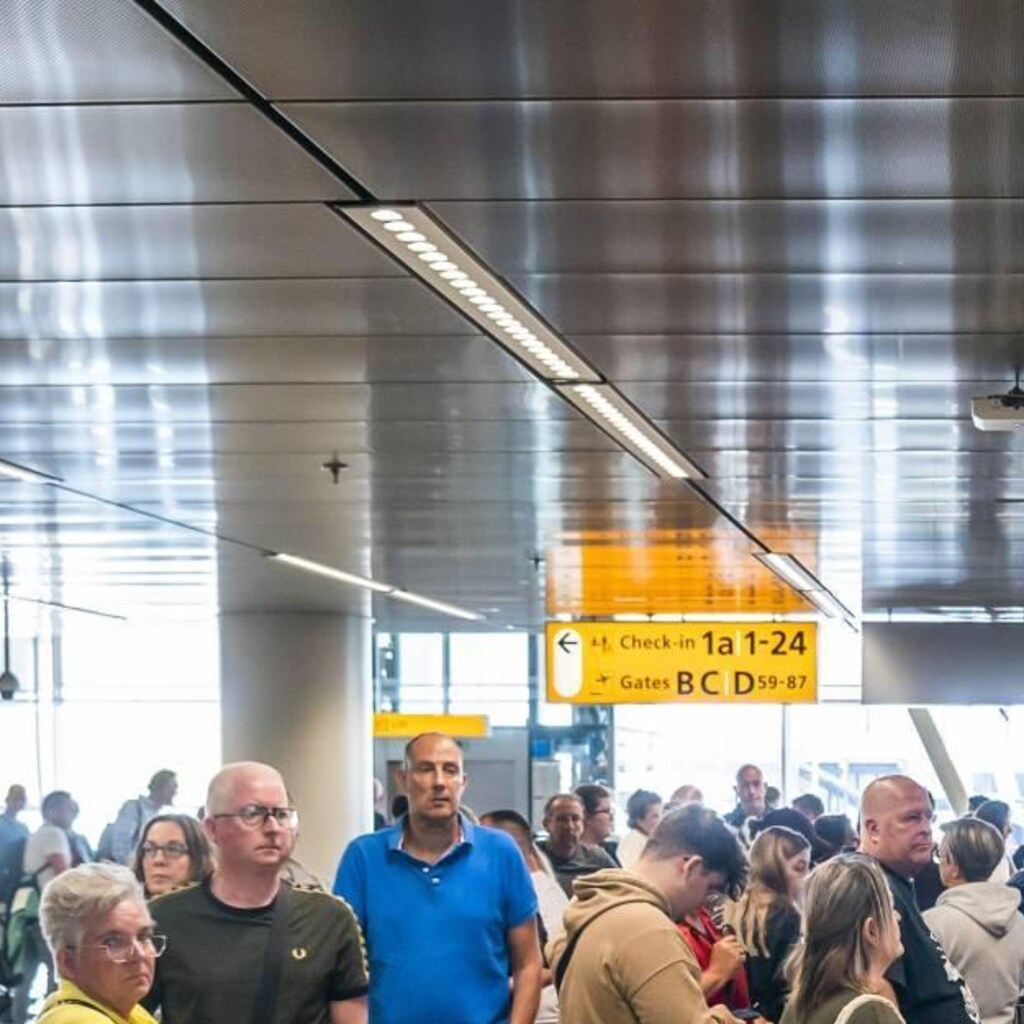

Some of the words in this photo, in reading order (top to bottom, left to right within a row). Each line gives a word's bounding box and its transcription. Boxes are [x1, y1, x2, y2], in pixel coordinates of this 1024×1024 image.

[620, 635, 695, 650] Check-in
[702, 631, 733, 655] 1a
[745, 631, 807, 655] 1-24
[620, 675, 670, 689] Gates
[677, 671, 694, 695] B
[700, 671, 719, 695] C
[735, 671, 755, 695] D
[758, 676, 807, 689] 59-87
